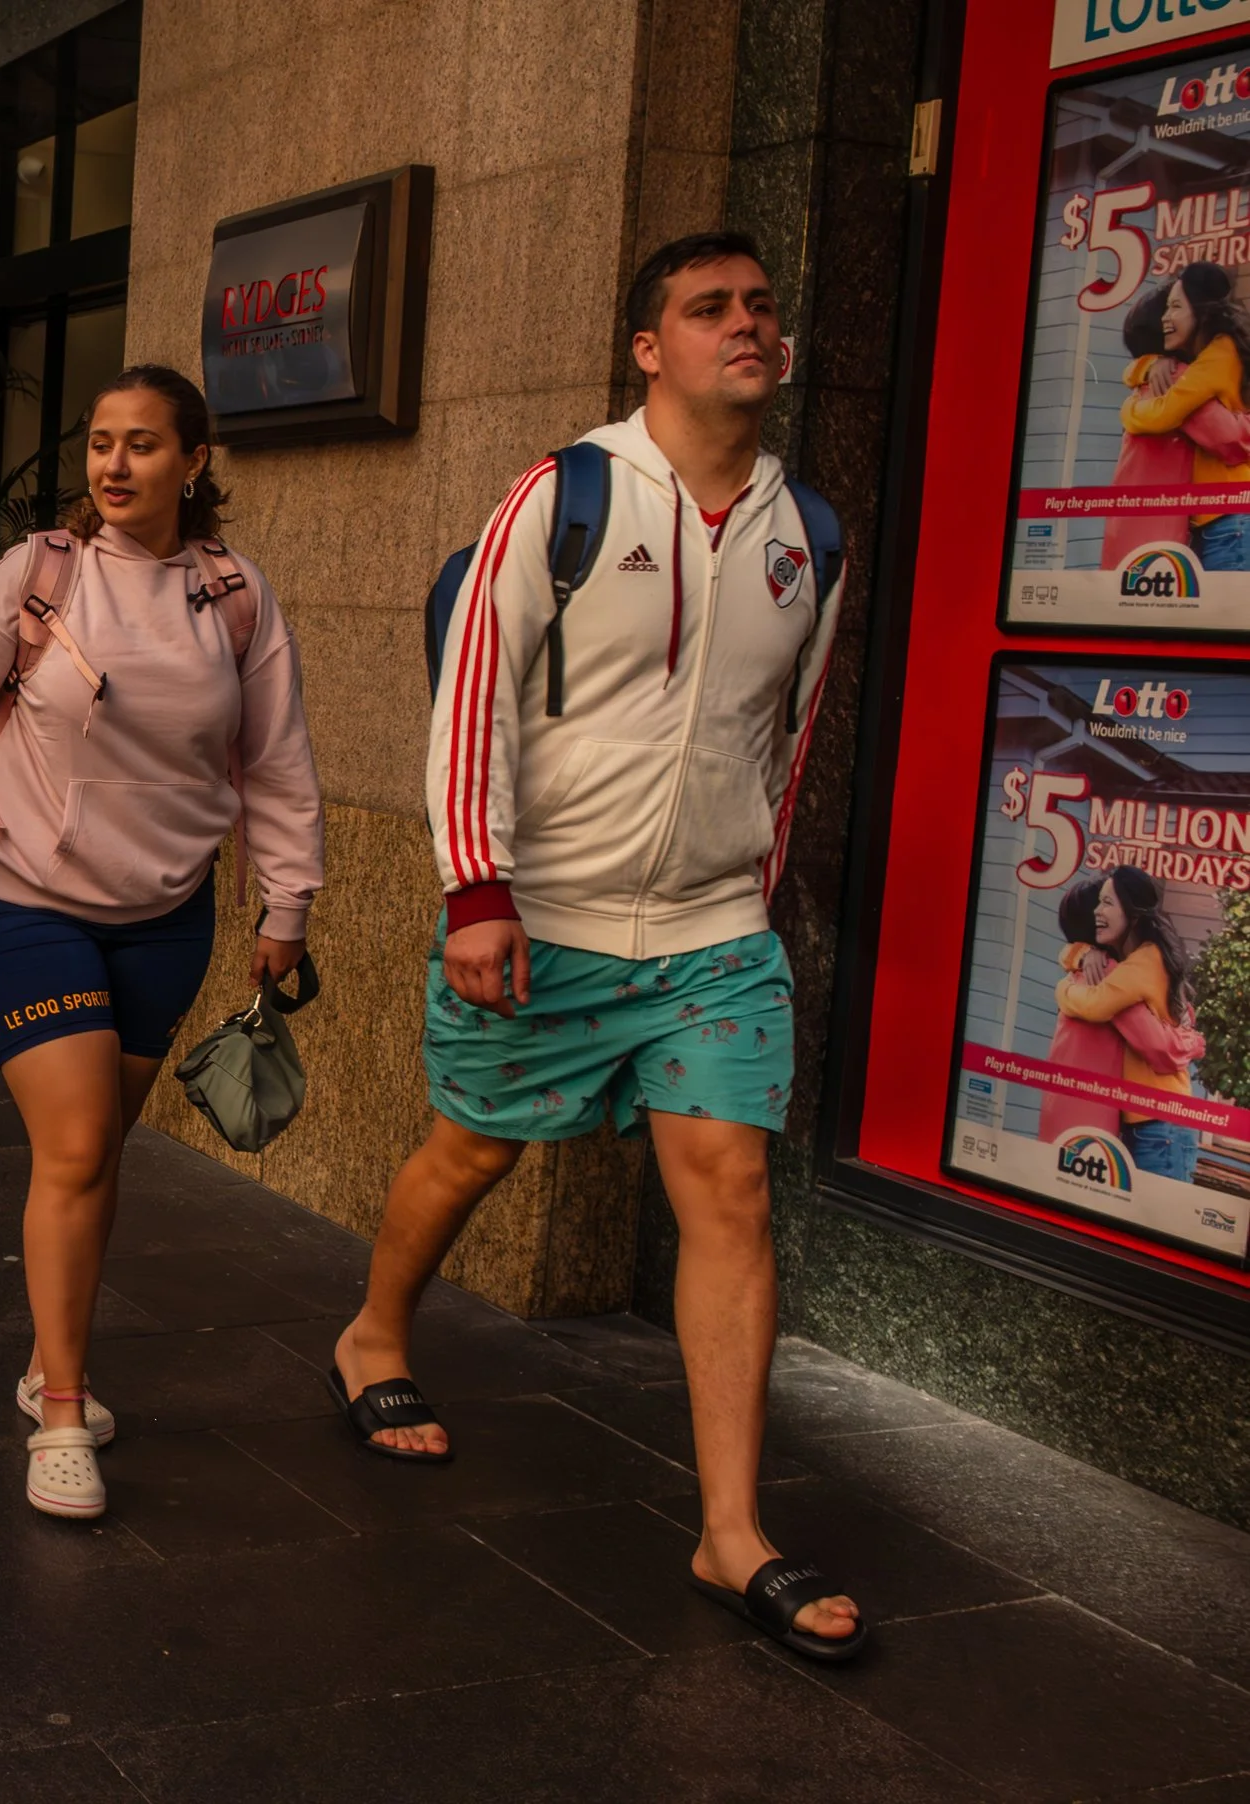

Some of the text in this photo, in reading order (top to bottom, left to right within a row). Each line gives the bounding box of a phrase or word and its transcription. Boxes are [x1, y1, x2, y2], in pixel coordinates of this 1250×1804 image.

[1218, 111, 1232, 127] be
[221, 265, 328, 330] RYDGES
[1045, 496, 1066, 512] Play
[1067, 495, 1083, 509] the
[1084, 498, 1114, 512] game
[1116, 494, 1140, 508] that
[1143, 493, 1179, 507] makes
[1180, 492, 1199, 506] the
[1199, 494, 1227, 505] most
[617, 561, 660, 572] adidas
[1121, 570, 1175, 597] Lott
[1092, 678, 1190, 720] Lotto
[1090, 721, 1187, 743] Wouldn't it be nice
[1000, 766, 1250, 889] $5 MILLION
[1085, 840, 1250, 891] SATURDAYS
[4, 1010, 23, 1030] LE
[24, 998, 60, 1021] COQ
[985, 1055, 1230, 1127] Play the game that makes the most millionaires!
[1058, 1146, 1107, 1184] Lott
